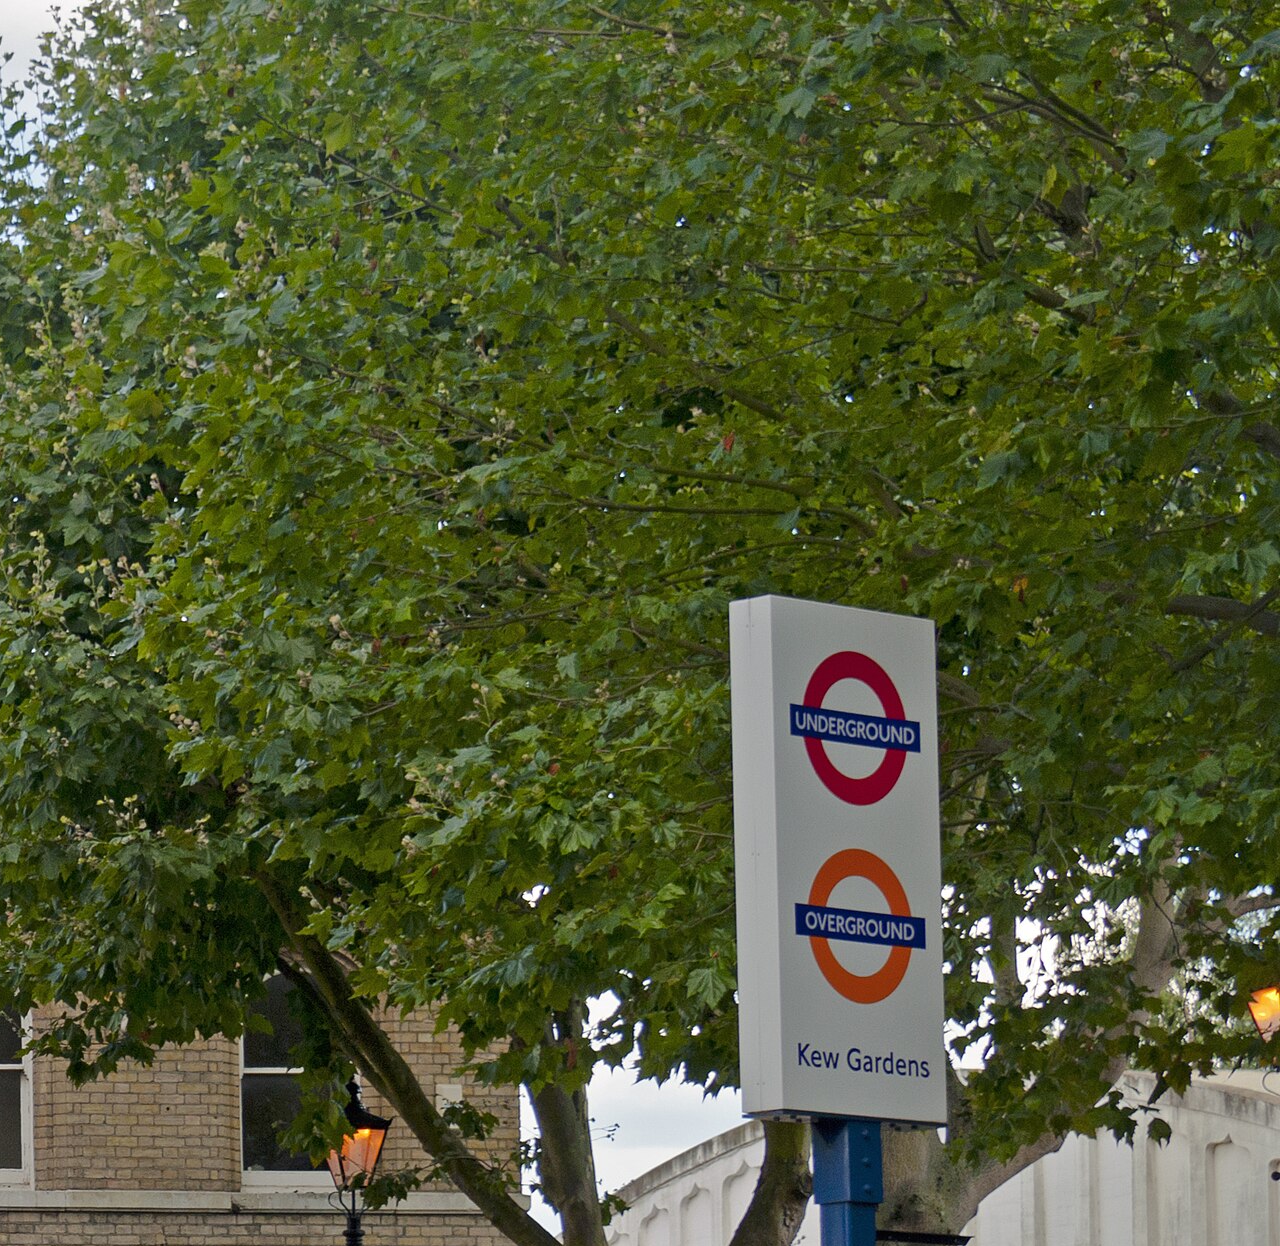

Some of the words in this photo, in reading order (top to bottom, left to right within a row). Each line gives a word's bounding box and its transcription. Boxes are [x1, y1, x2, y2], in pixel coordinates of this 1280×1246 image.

[795, 711, 915, 745] UNDERGROUND
[805, 911, 915, 941] OVERGROUND
[798, 1043, 839, 1069] Kew
[847, 1048, 930, 1078] Gardens
